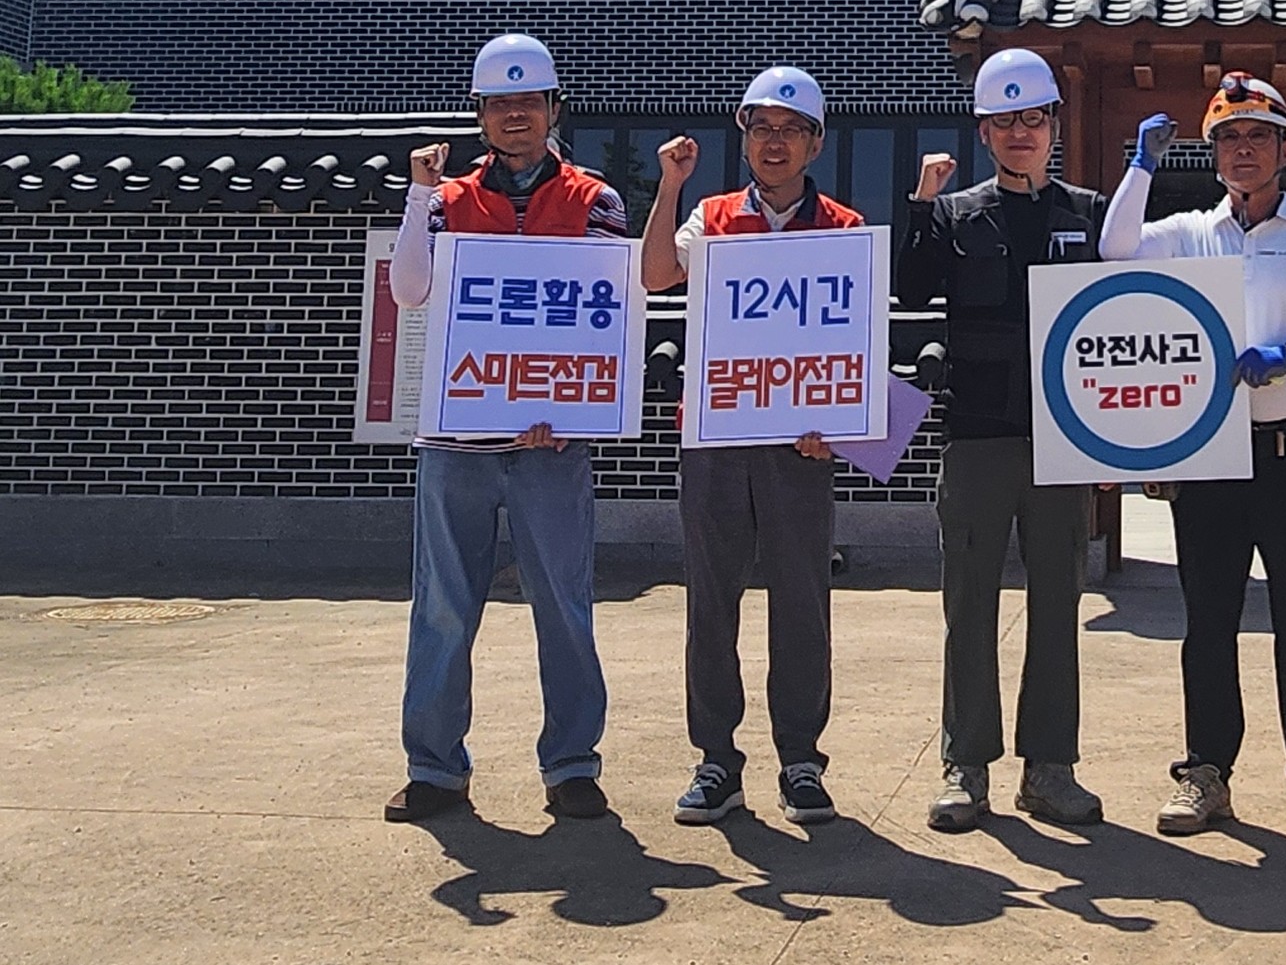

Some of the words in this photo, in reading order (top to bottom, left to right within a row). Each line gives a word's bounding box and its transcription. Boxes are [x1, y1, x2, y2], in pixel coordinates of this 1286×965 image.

[456, 275, 622, 330] 드론활용
[725, 274, 855, 328] 12시간
[1075, 332, 1202, 368] 안전사고
[448, 351, 618, 404] 스마트점검
[707, 352, 865, 411] 릴레이점검
